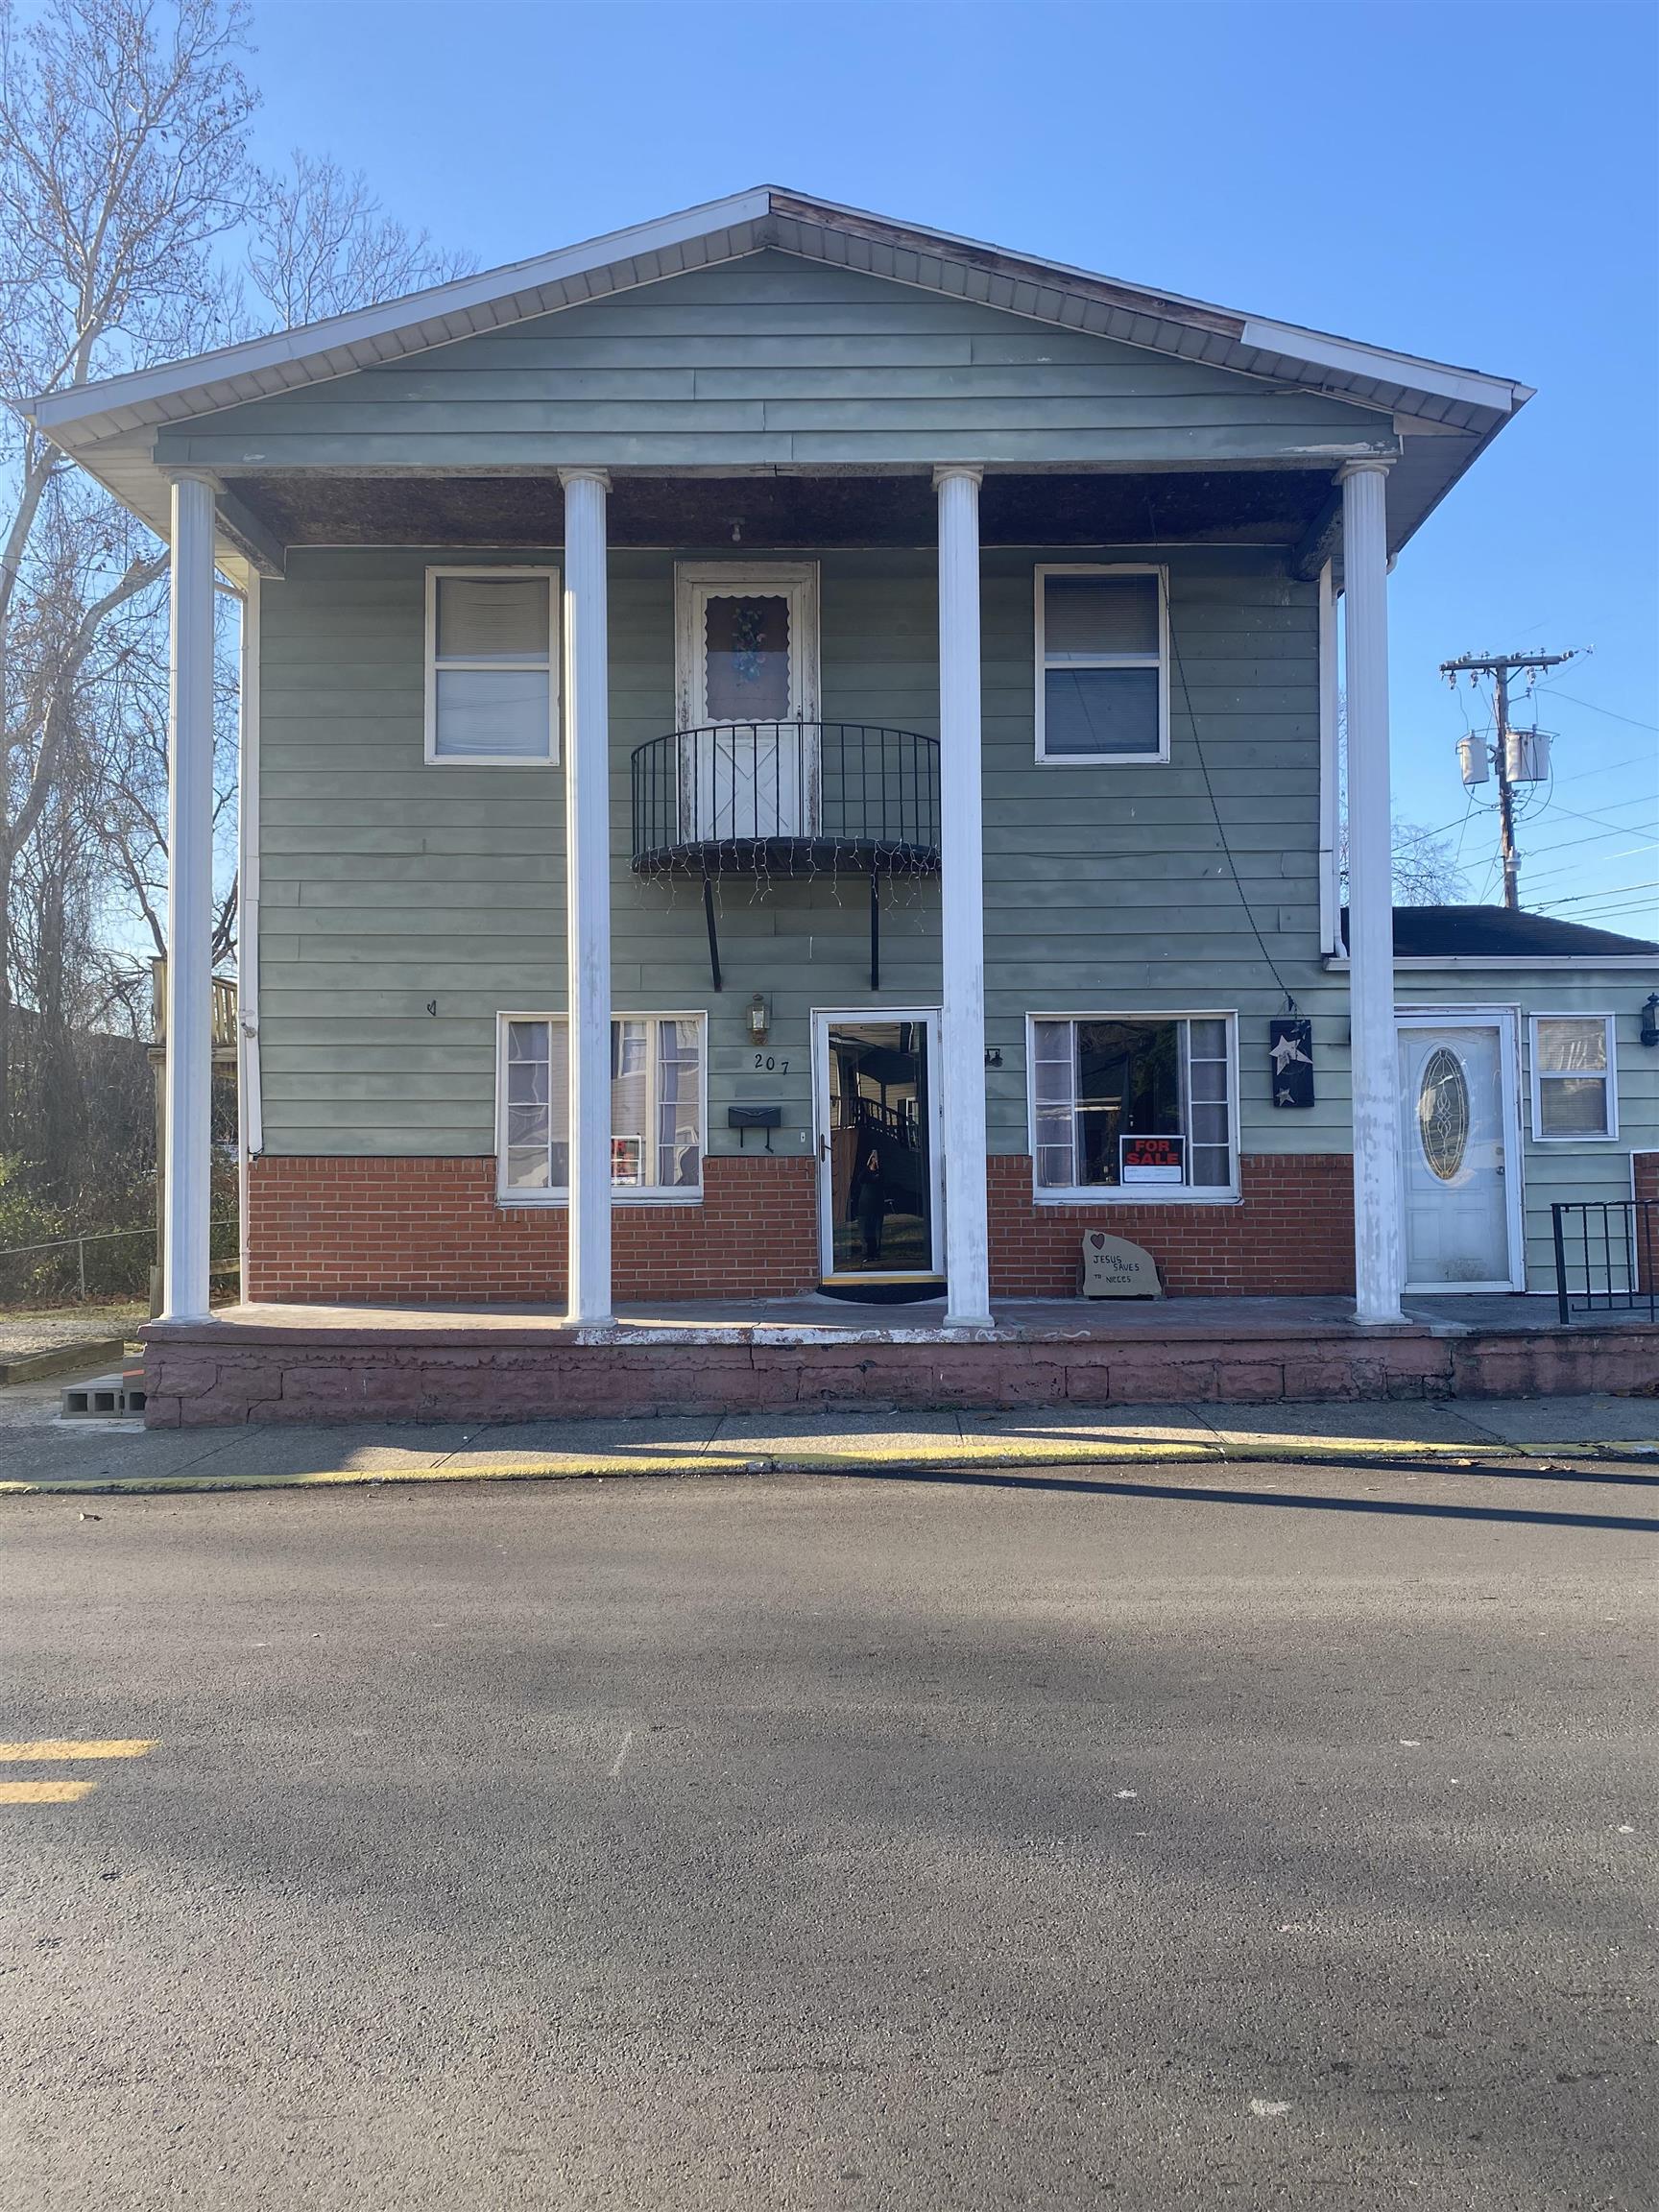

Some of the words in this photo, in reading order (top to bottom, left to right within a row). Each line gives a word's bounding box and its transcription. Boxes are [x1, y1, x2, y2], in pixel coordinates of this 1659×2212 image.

[755, 1053, 789, 1075] 207
[1135, 1140, 1169, 1152] FOR
[1126, 1152, 1179, 1165] SALE
[1093, 1255, 1122, 1263] JESUS
[1113, 1263, 1140, 1272] SAVES
